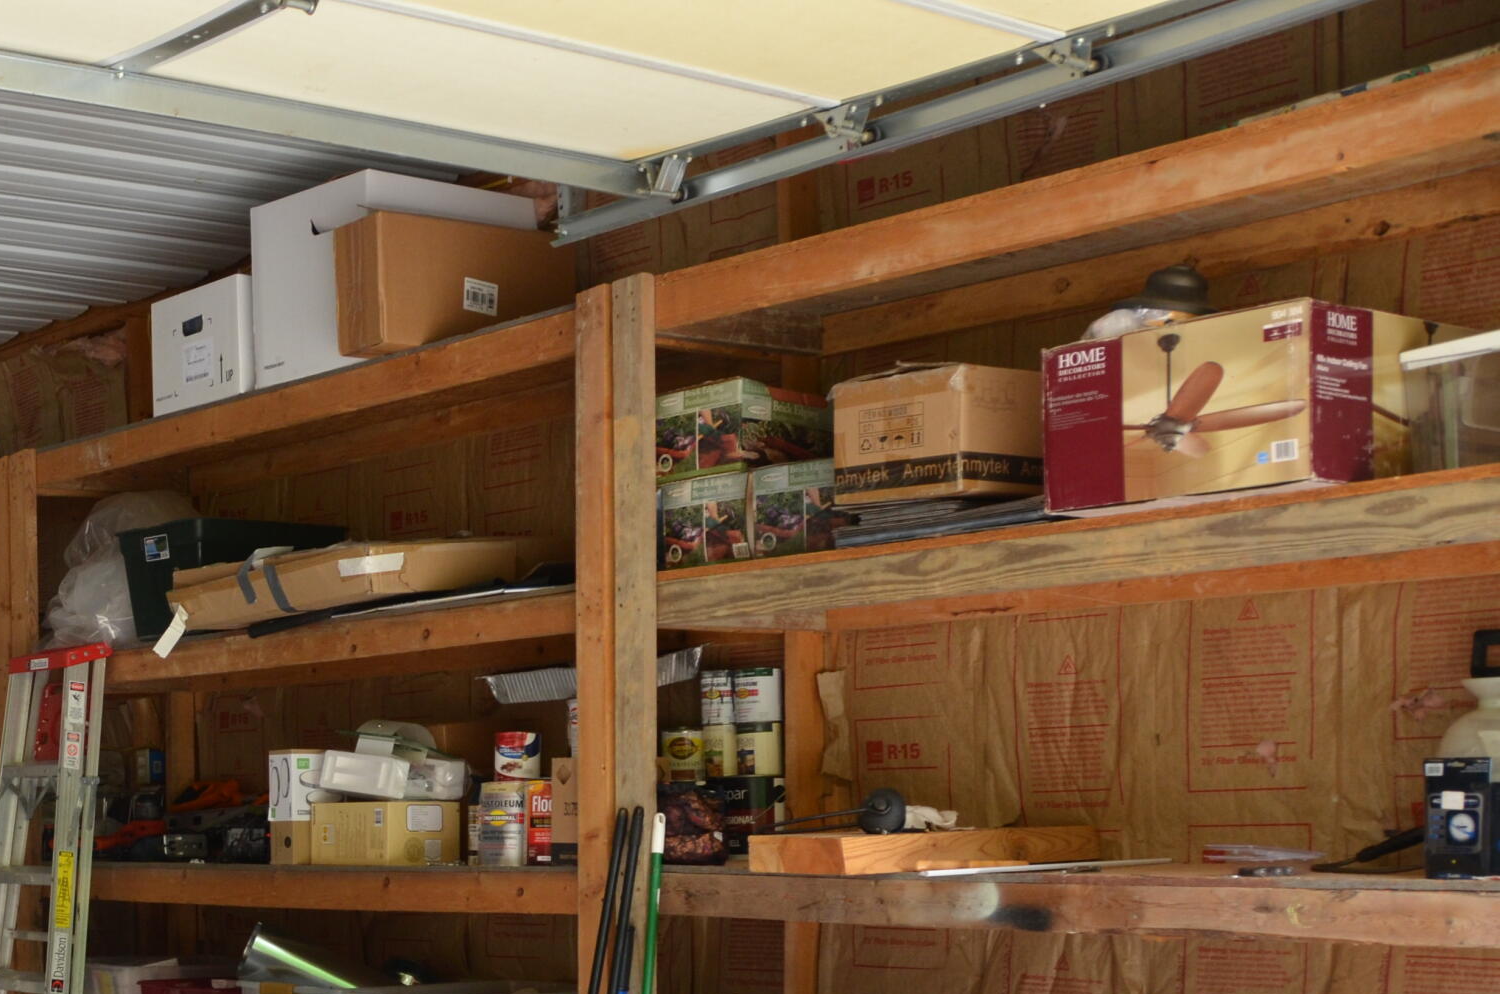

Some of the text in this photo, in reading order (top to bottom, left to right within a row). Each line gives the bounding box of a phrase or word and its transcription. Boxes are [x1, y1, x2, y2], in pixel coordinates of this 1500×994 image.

[1327, 311, 1357, 331] HOME
[1058, 346, 1107, 368] HOME
[225, 368, 234, 383] UP
[1058, 362, 1106, 376] DECORATORS
[959, 456, 1009, 476] nmytek
[836, 466, 890, 488] nmytek
[886, 742, 921, 760] R-15
[52, 935, 67, 978] Davidson
